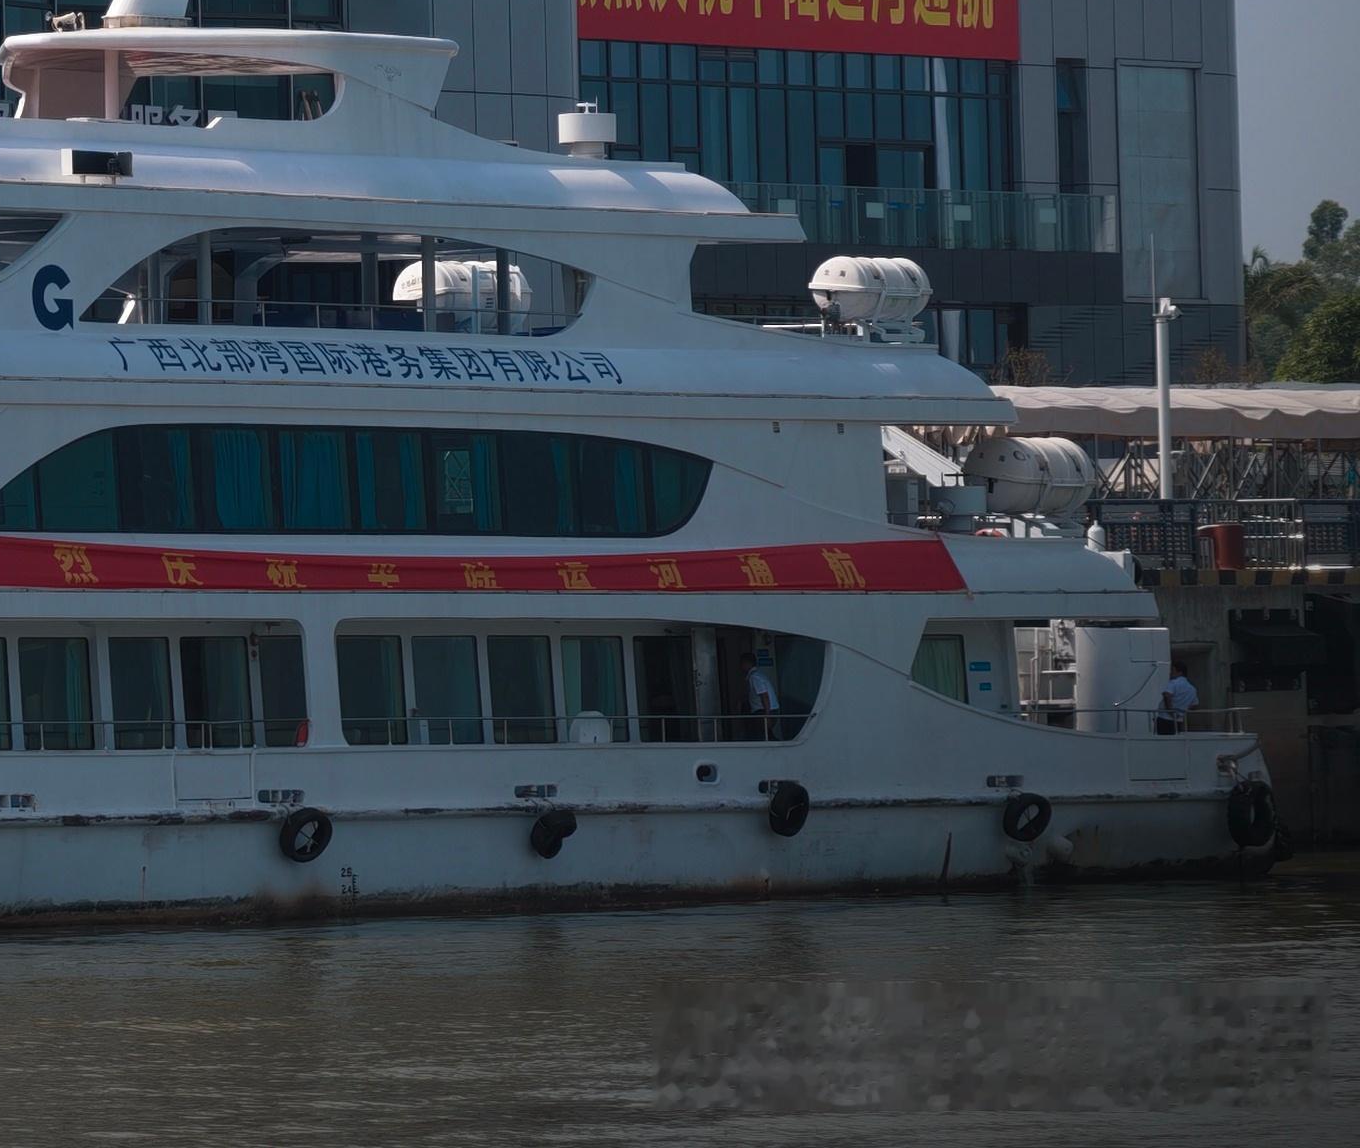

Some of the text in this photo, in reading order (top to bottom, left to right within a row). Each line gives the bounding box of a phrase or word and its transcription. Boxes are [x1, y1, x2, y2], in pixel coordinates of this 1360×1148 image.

[31, 263, 74, 332] G
[107, 336, 623, 385] 广西北部湾国际港务集团有限公司
